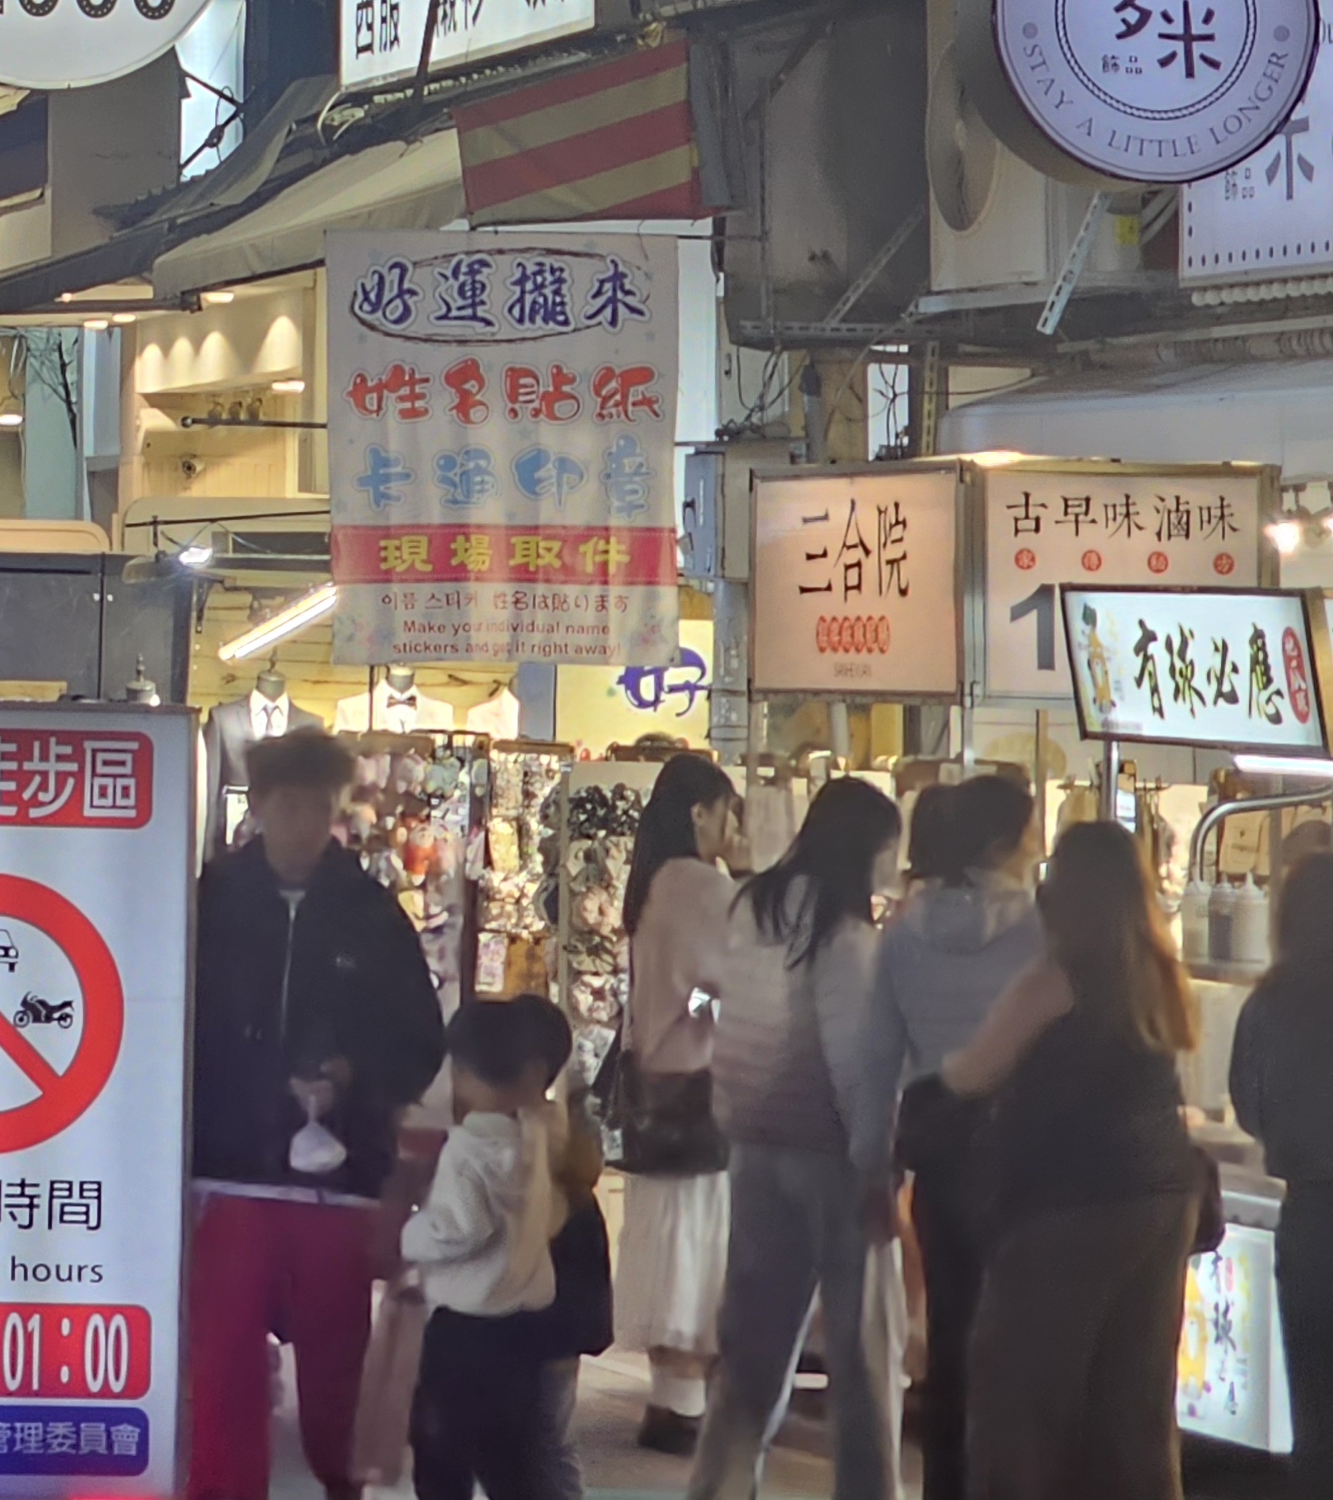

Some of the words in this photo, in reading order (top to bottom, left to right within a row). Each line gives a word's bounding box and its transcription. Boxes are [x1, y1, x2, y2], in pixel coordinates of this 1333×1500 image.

[1023, 43, 1074, 112] STAY
[1076, 116, 1095, 137] A
[1107, 129, 1201, 159] LITTLE
[1208, 50, 1290, 146] LONGER
[346, 357, 663, 424] 姓名貼紙
[354, 434, 652, 518] 卡通印章
[1005, 491, 1241, 543] 古早味滷味
[379, 536, 631, 574] 現場取件
[798, 497, 910, 604] 三合院
[392, 642, 459, 655] stickers
[465, 642, 489, 655] and
[531, 642, 570, 659] right
[403, 620, 446, 634] Make
[485, 620, 561, 635] individual
[565, 623, 611, 636] name
[10, 1255, 105, 1284] hours
